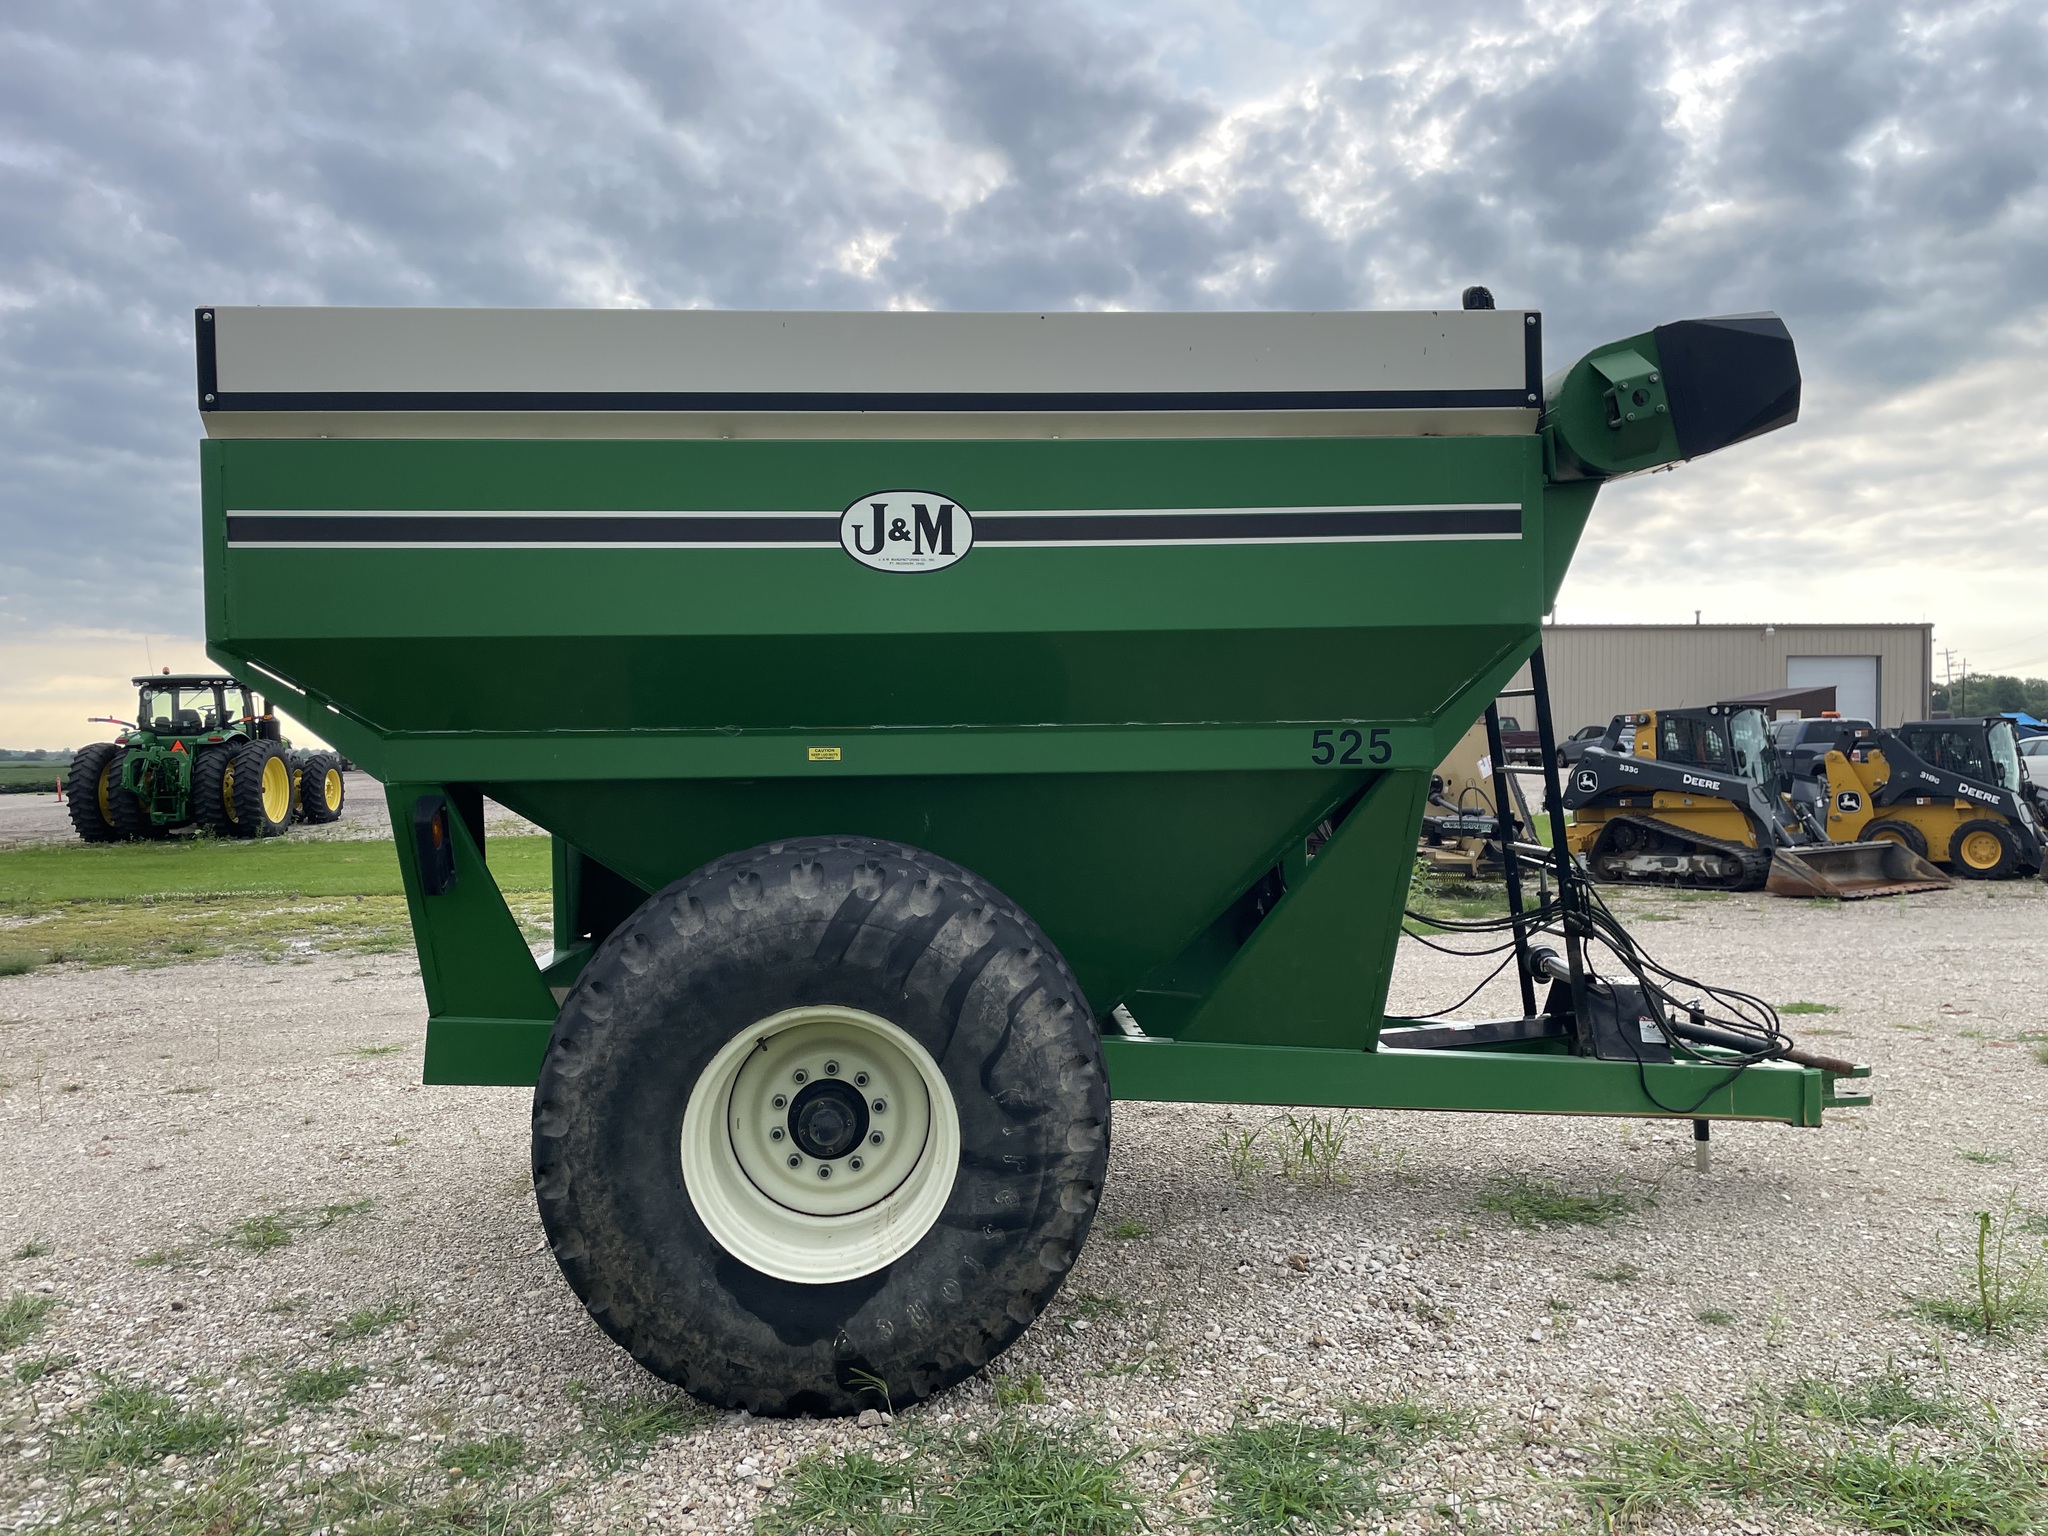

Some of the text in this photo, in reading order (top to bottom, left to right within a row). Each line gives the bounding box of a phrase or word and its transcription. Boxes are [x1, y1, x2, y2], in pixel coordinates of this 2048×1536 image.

[851, 503, 956, 555] J&M
[1311, 728, 1393, 765] 525
[1619, 763, 1639, 774] 333G
[1919, 770, 1941, 785] 318G
[1682, 773, 1721, 791] DEERE
[1958, 782, 2001, 805] DEERE
